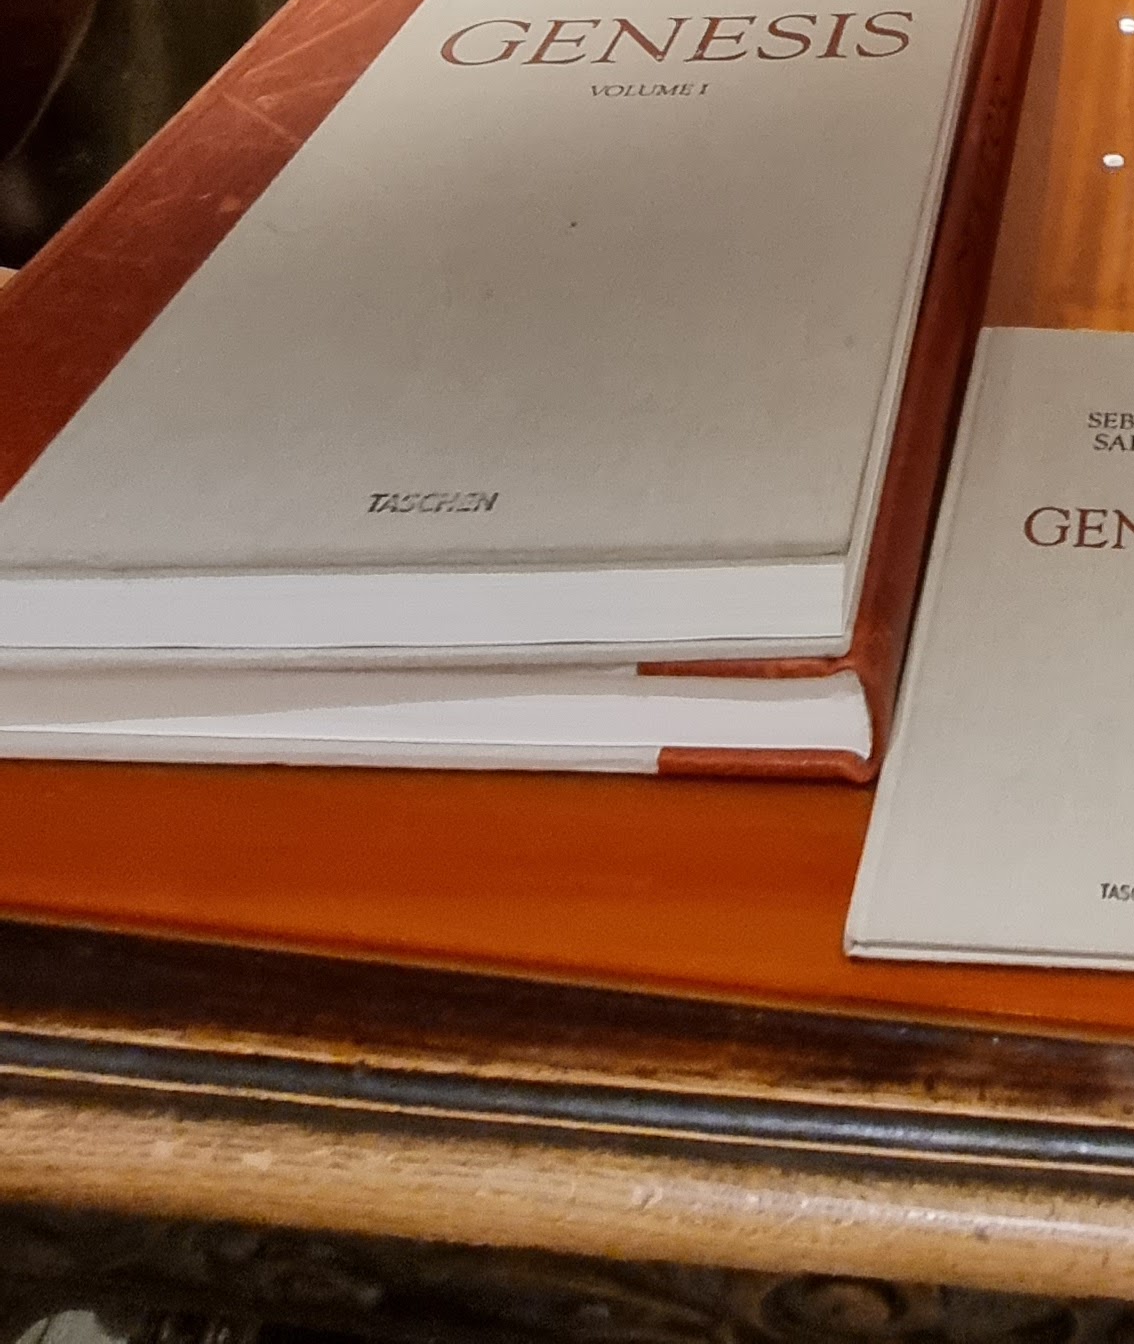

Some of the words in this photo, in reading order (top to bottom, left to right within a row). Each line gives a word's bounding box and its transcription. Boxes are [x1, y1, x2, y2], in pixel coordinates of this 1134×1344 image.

[440, 11, 914, 67] GENESIS
[591, 82, 694, 97] VOLUME
[698, 82, 709, 96] I
[367, 491, 500, 514] TASCHEN
